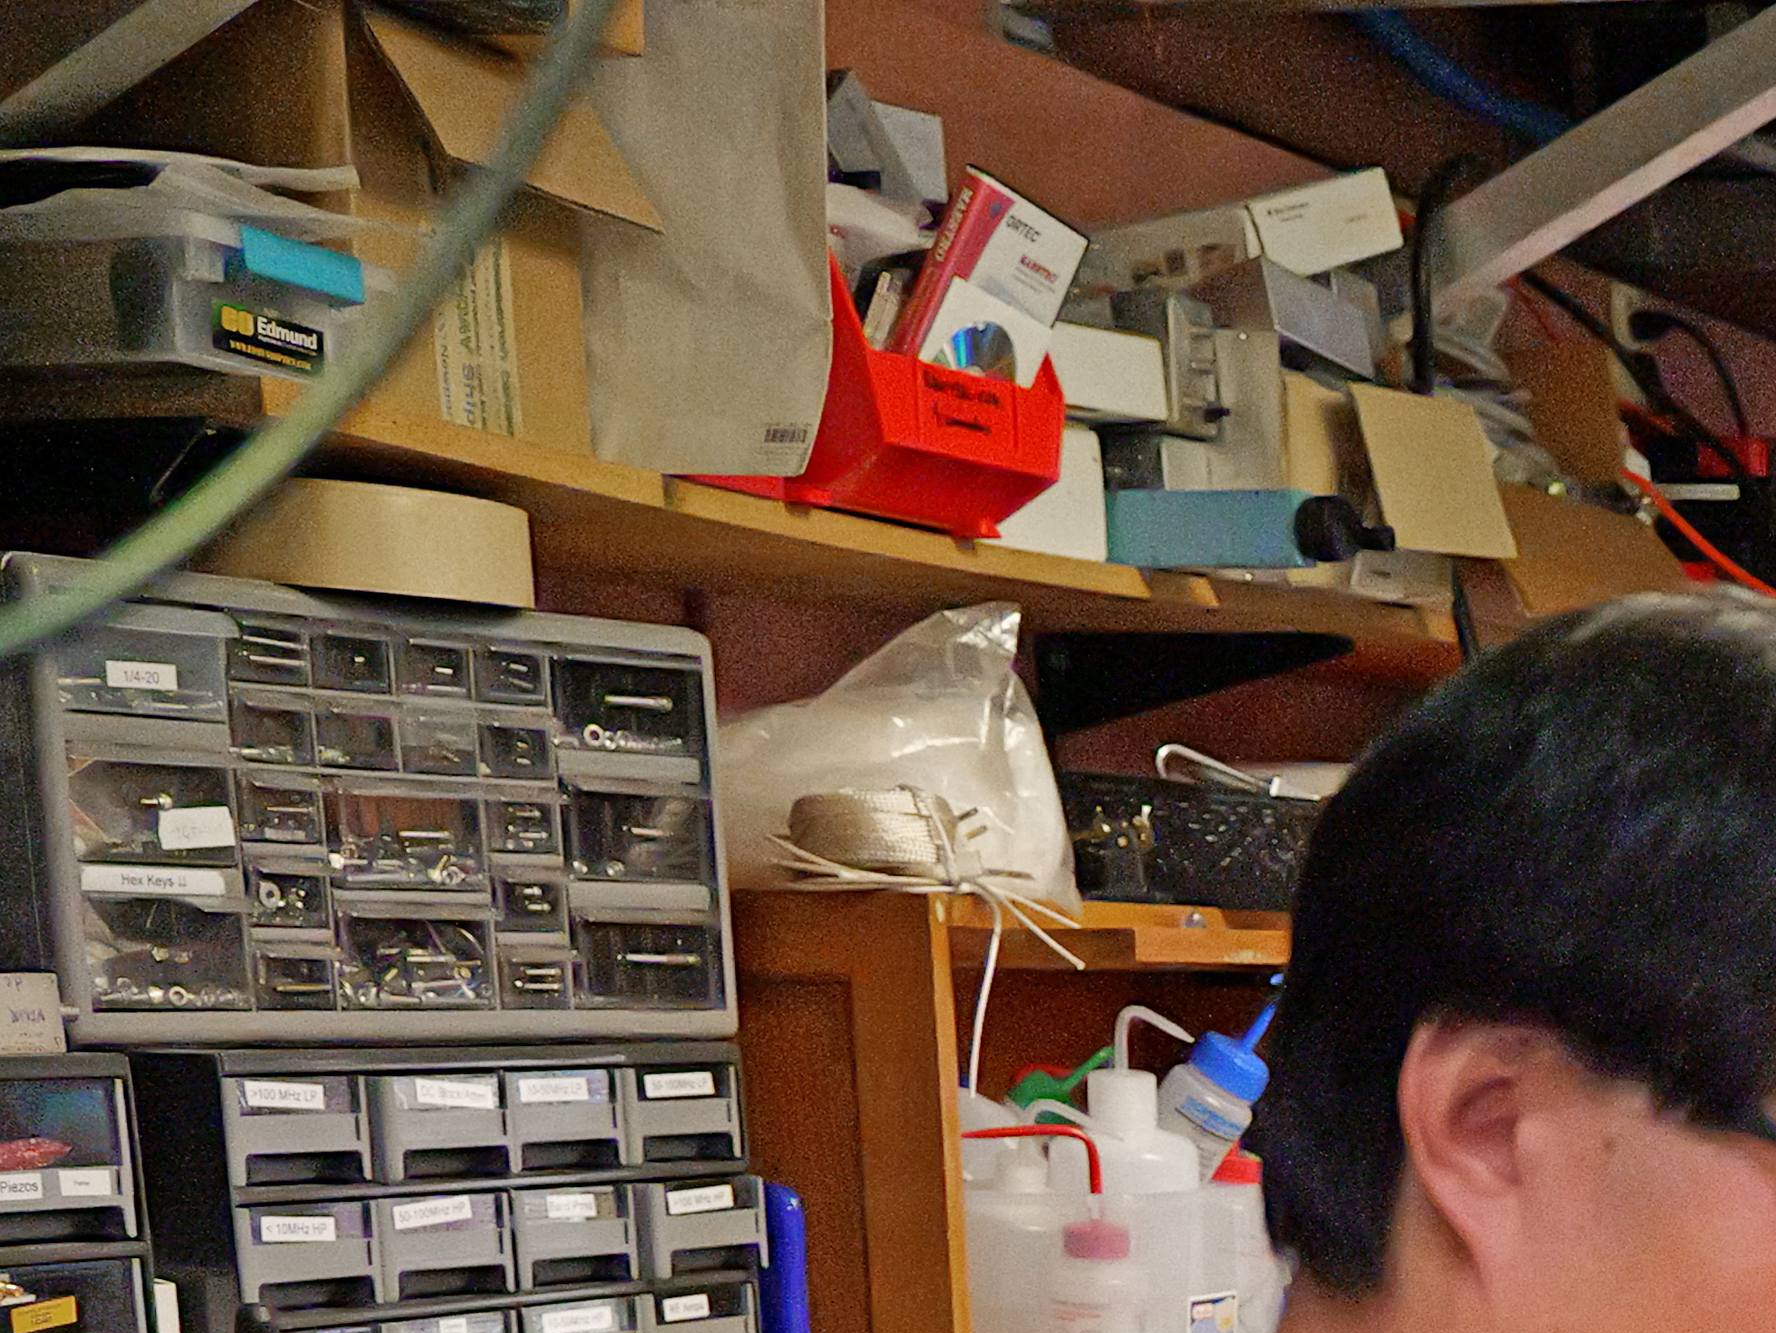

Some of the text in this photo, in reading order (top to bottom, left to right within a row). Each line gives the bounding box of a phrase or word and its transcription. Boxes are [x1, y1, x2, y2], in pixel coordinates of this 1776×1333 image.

[1005, 215, 1042, 243] ORTEC
[257, 315, 318, 350] Edmund
[123, 669, 161, 685] 1/4-20
[121, 874, 143, 886] Hex
[147, 874, 174, 889] Keys
[278, 1089, 301, 1102] MHz
[303, 1090, 318, 1102] LP
[1, 1181, 39, 1194] Piezos
[451, 1200, 467, 1214] HP
[276, 1222, 311, 1235] 10MHz
[312, 1222, 328, 1235] HP
